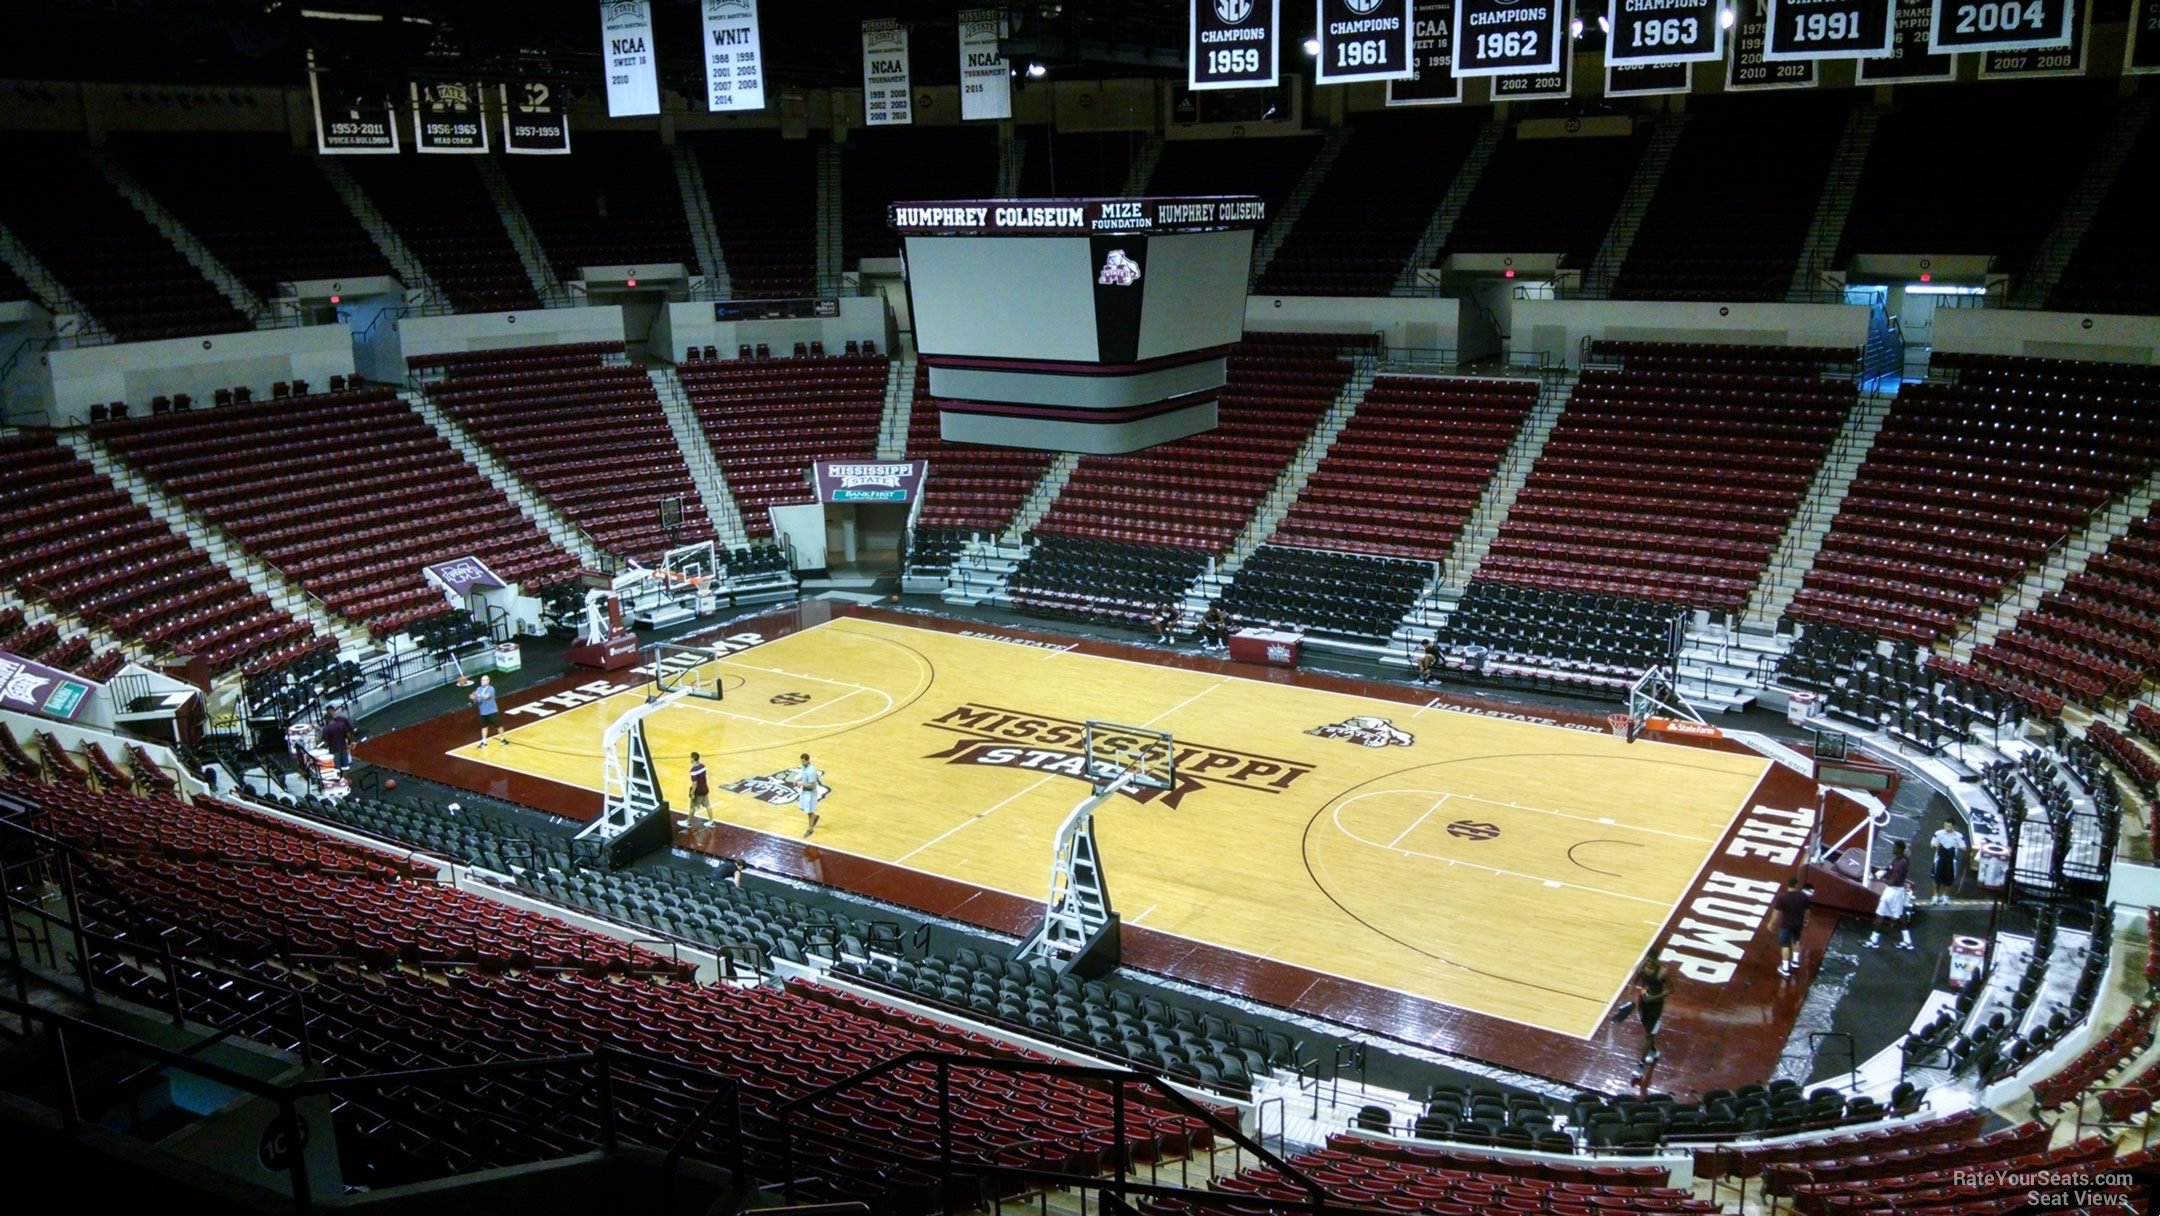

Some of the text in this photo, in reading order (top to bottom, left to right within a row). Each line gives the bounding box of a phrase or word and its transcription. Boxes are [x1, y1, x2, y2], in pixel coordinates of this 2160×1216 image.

[1469, 8, 1547, 26] CHAMPIONS
[1956, 1, 2045, 34] 2004
[1329, 16, 1400, 35] CHAMPIONS
[1631, 17, 1699, 47] 1963
[1793, 11, 1860, 42] 1991
[712, 28, 751, 46] WNIT
[1201, 27, 1265, 43] CHAMPIONS
[611, 37, 647, 55] NCAA
[1438, 38, 1448, 49] 16
[1476, 30, 1538, 59] 1962
[968, 52, 1001, 68] NCAA
[1336, 39, 1387, 67] 1961
[1740, 53, 1763, 65] 200
[613, 56, 635, 67] SWEET
[871, 60, 903, 74] NCAA
[1208, 49, 1259, 74] 1959
[1428, 55, 1451, 68] 1995
[1992, 54, 2071, 70] 2007 2008
[1739, 65, 1805, 80] 2010 2012
[965, 84, 983, 94] 2015
[1501, 76, 1562, 92] 2002 2003
[331, 123, 384, 135] 1953-2011
[426, 123, 478, 135] 1956-1965
[514, 125, 560, 138] 1957-1959
[895, 206, 1084, 232] HUMPHREY COLISEUM
[1101, 203, 1143, 219] MIZE
[1158, 200, 1265, 228] HUMPHREY COLISEUM
[1091, 218, 1152, 230] FOUNDATION
[829, 464, 913, 477] MISSISSIPPI
[848, 475, 893, 487] STATE
[504, 680, 630, 718] THE
[930, 705, 1311, 790] MISSISSIPPI
[977, 748, 1142, 795] STATE
[1724, 804, 1816, 866] THE
[1657, 870, 1781, 984] HUMP
